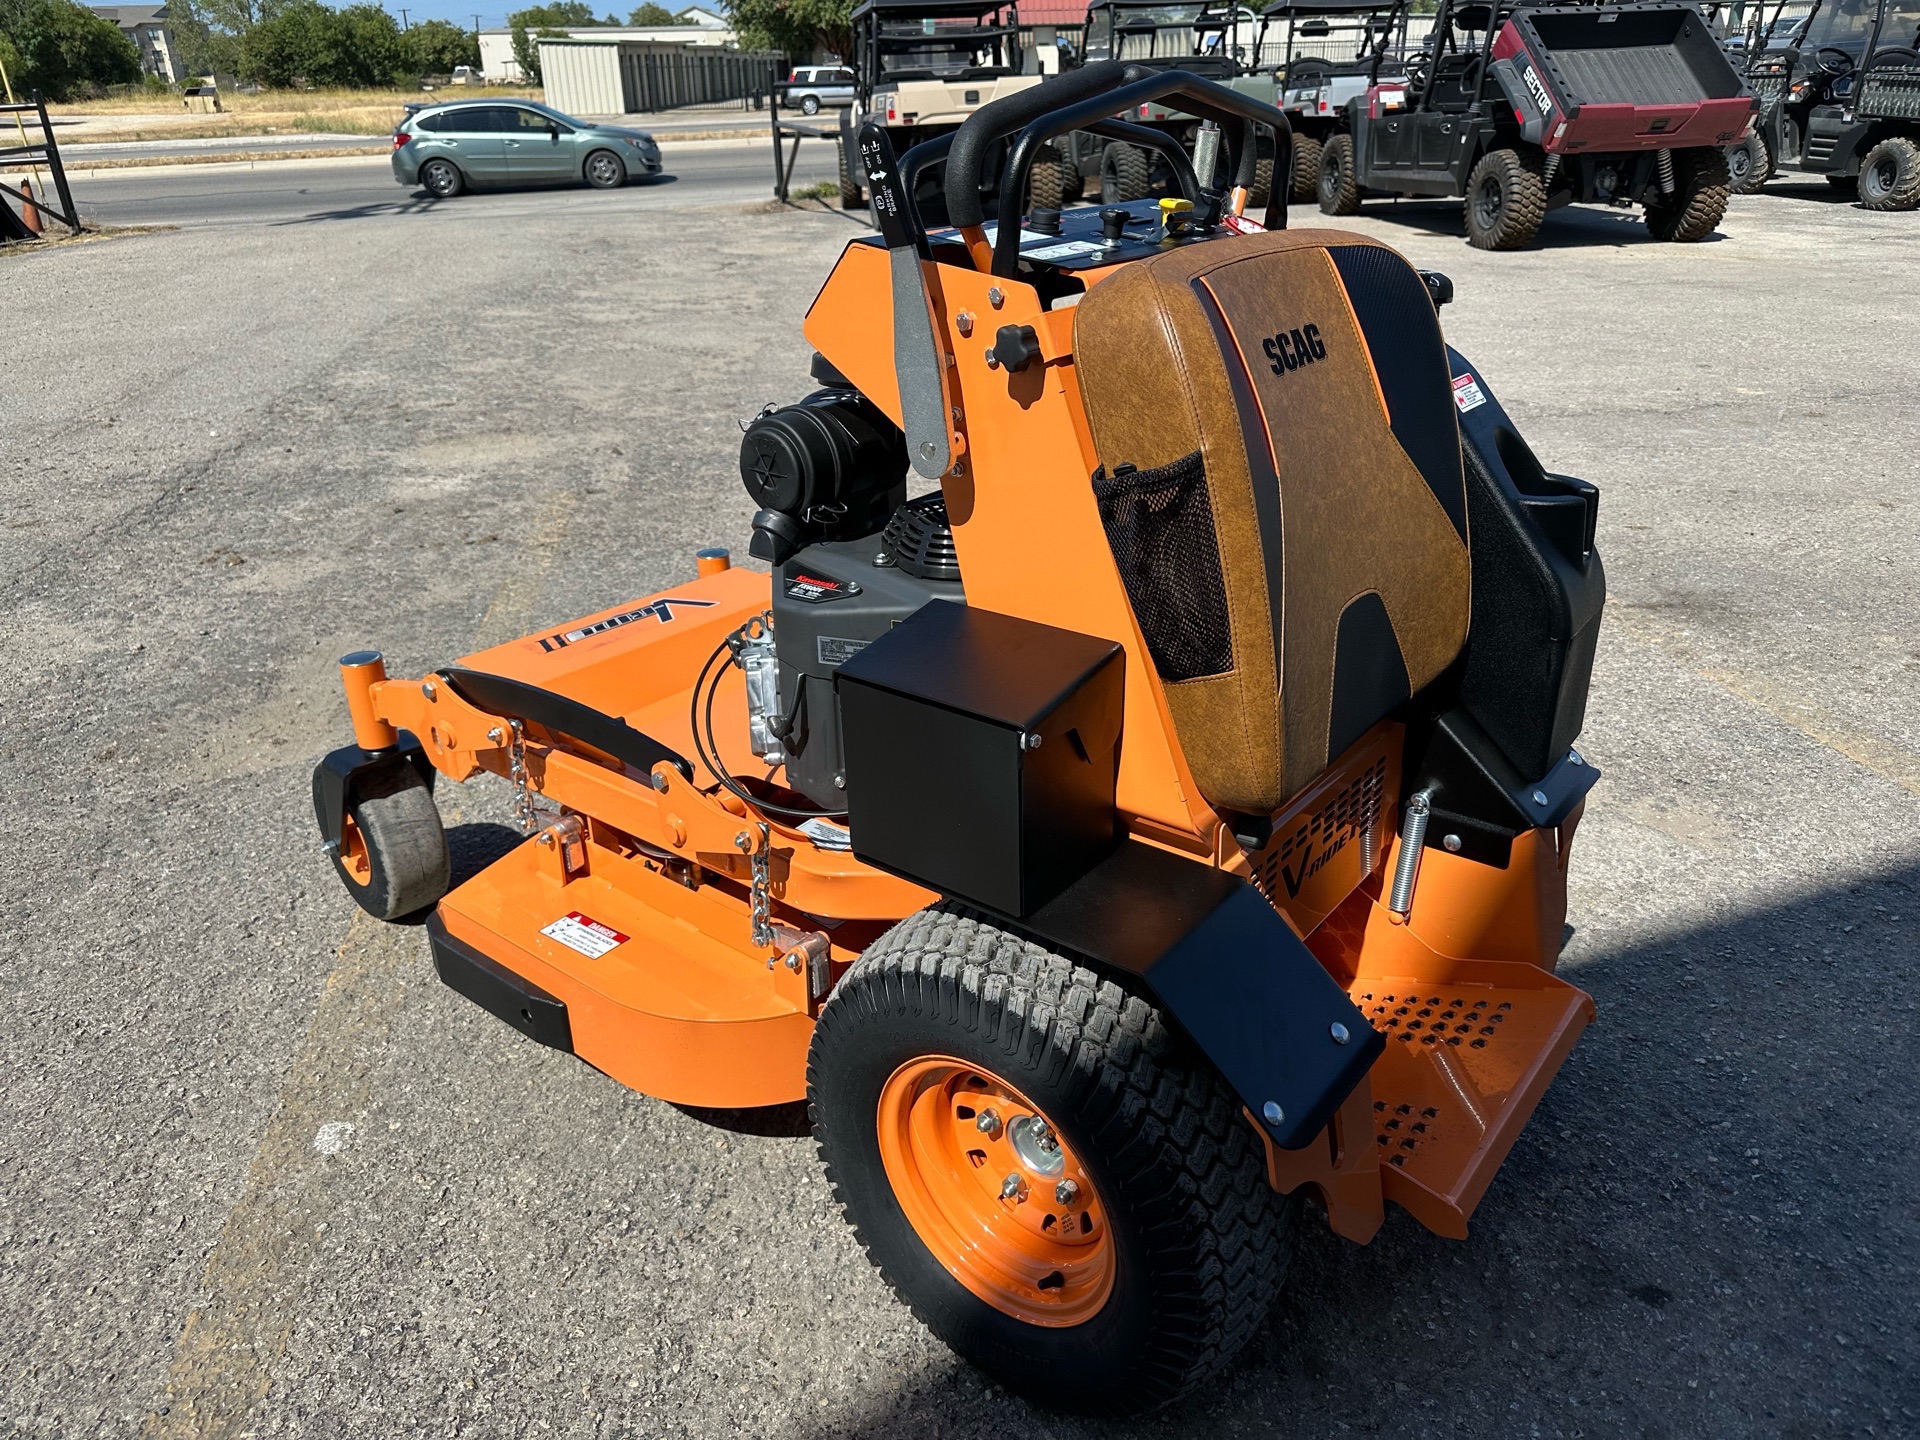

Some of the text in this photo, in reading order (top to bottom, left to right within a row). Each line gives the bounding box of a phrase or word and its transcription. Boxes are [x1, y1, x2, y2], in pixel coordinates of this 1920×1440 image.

[1523, 65, 1552, 115] SECTOR
[876, 154, 882, 164] ON
[882, 185, 894, 216] PARKING
[886, 188, 897, 212] BRAKE
[1262, 323, 1327, 377] SCAG
[796, 574, 840, 589] Kawasaki
[588, 922, 618, 938] DANGER
